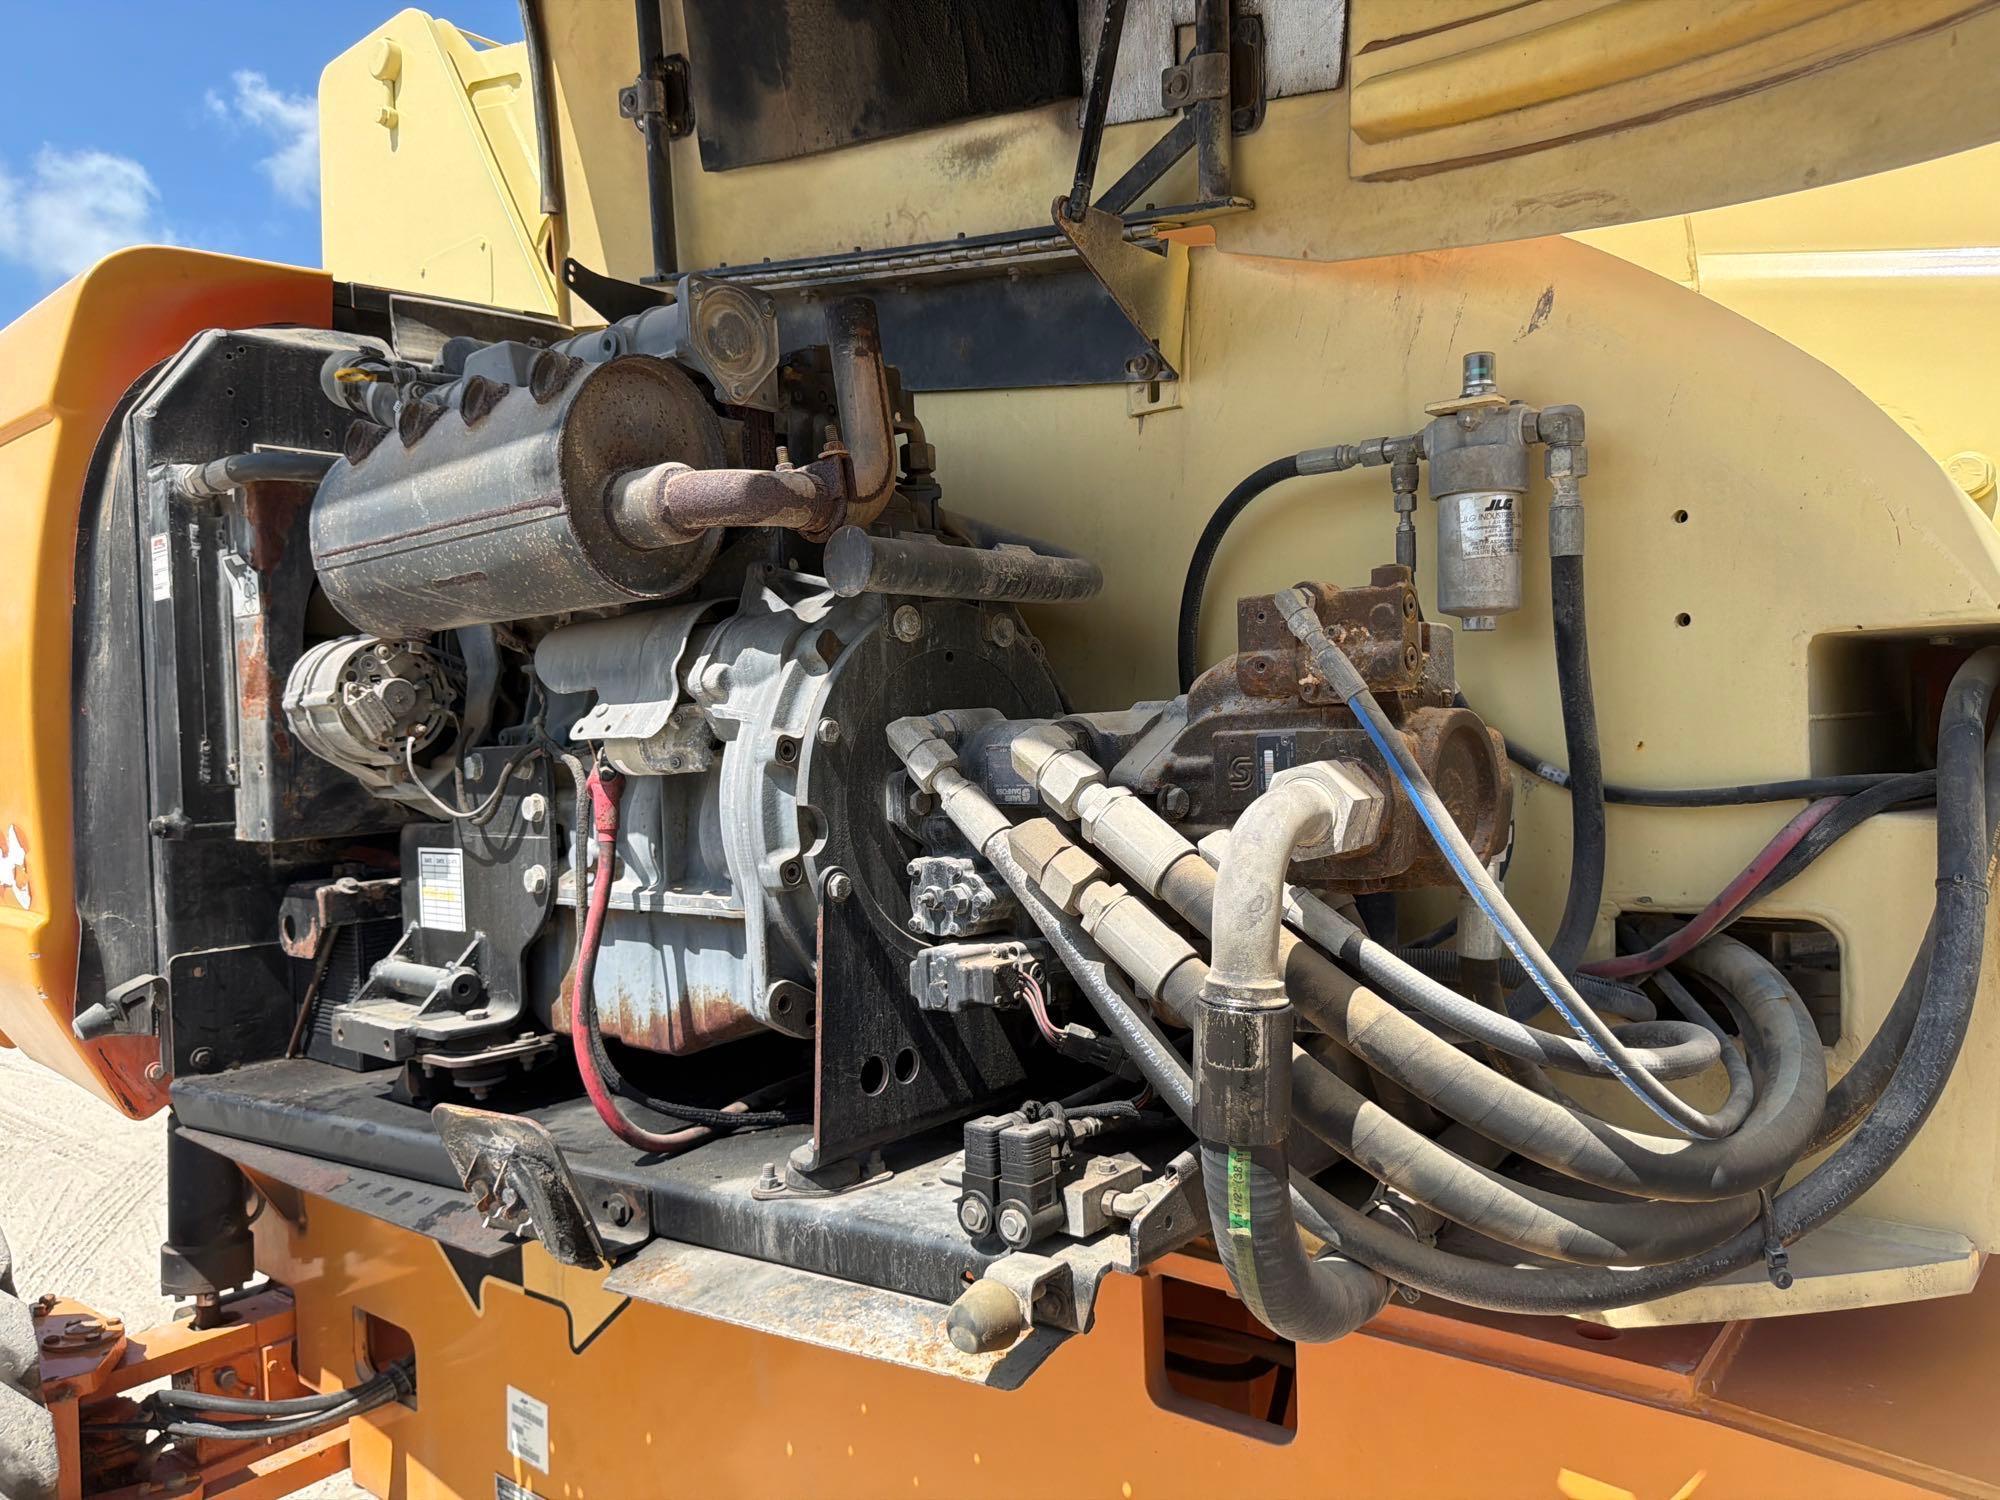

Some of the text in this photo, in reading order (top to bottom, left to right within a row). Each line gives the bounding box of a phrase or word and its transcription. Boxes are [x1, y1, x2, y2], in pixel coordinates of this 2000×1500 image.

[1485, 498, 1513, 511] JLG
[1088, 971, 1107, 994] MPa)
[1104, 994, 1123, 1015] MAX
[1120, 1015, 1136, 1032] WP
[1131, 1030, 1148, 1049] R17
